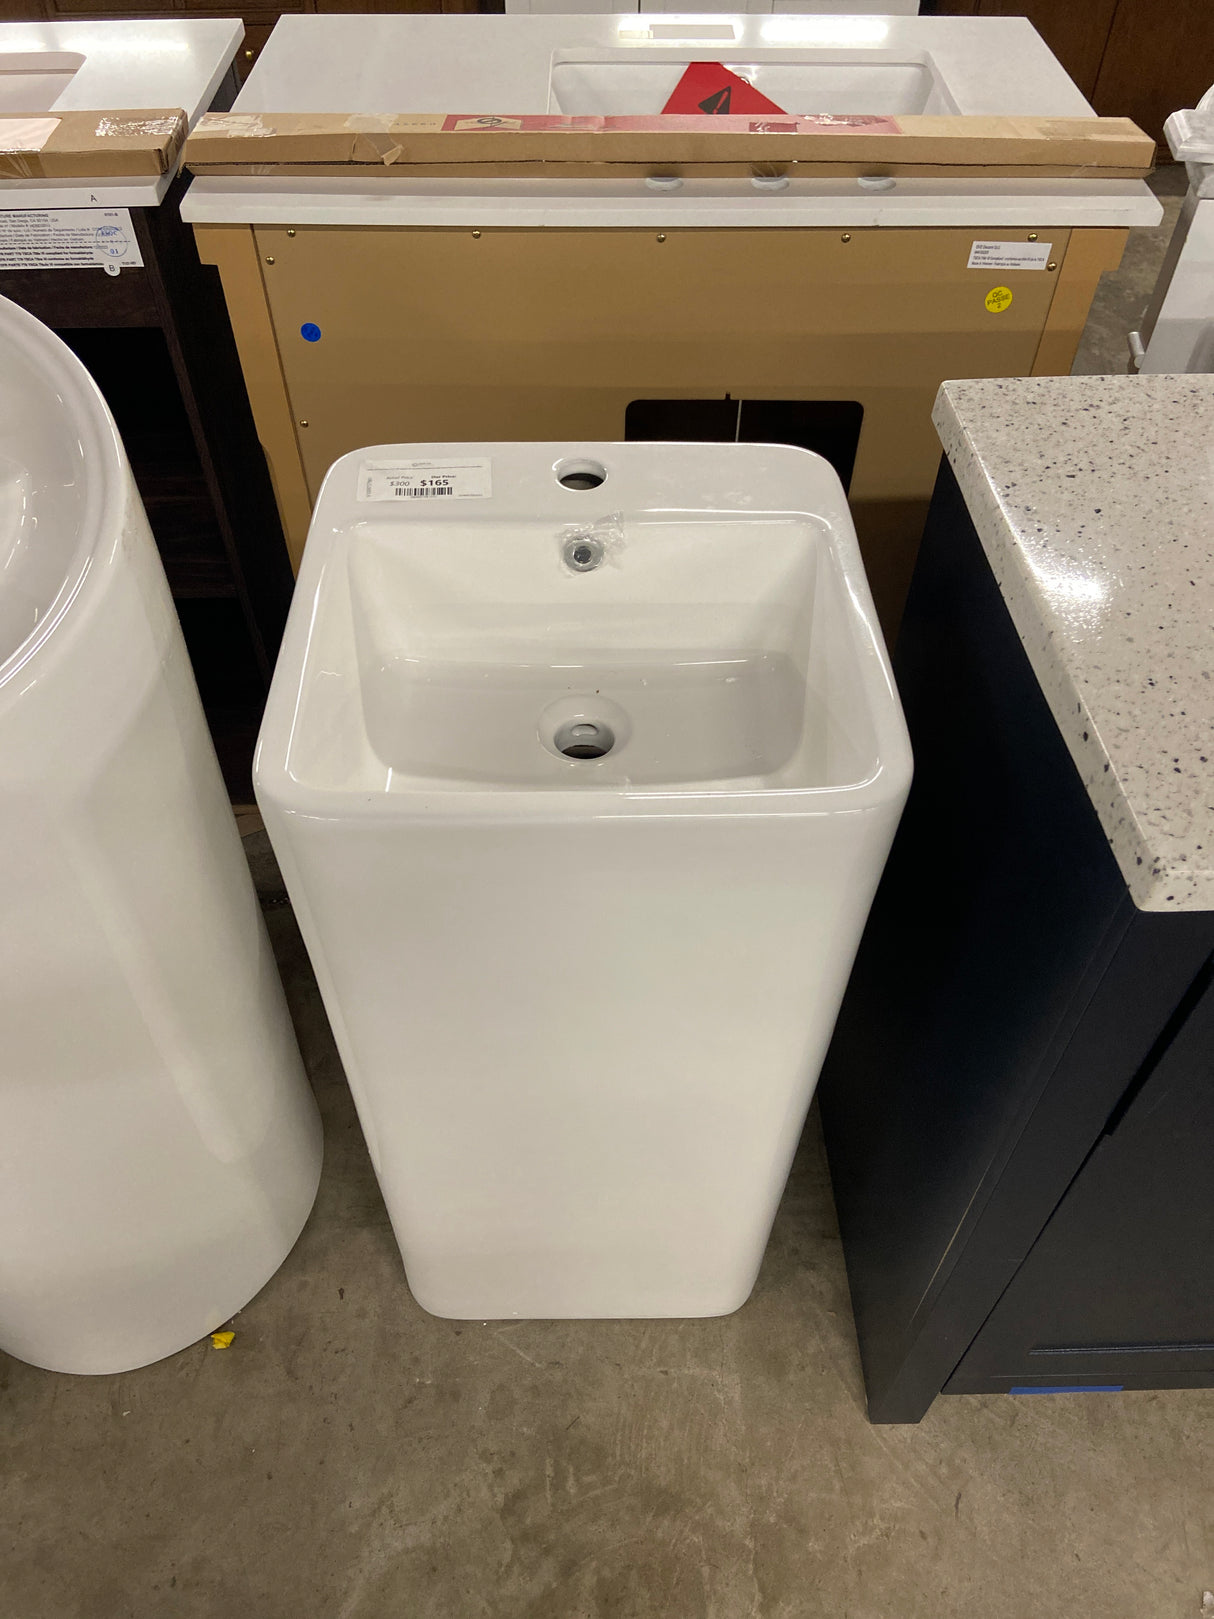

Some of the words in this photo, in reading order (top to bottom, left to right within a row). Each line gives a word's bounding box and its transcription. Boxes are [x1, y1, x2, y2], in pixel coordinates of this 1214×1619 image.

[90, 194, 98, 202] A
[108, 264, 116, 272] B
[419, 479, 449, 487] $165
